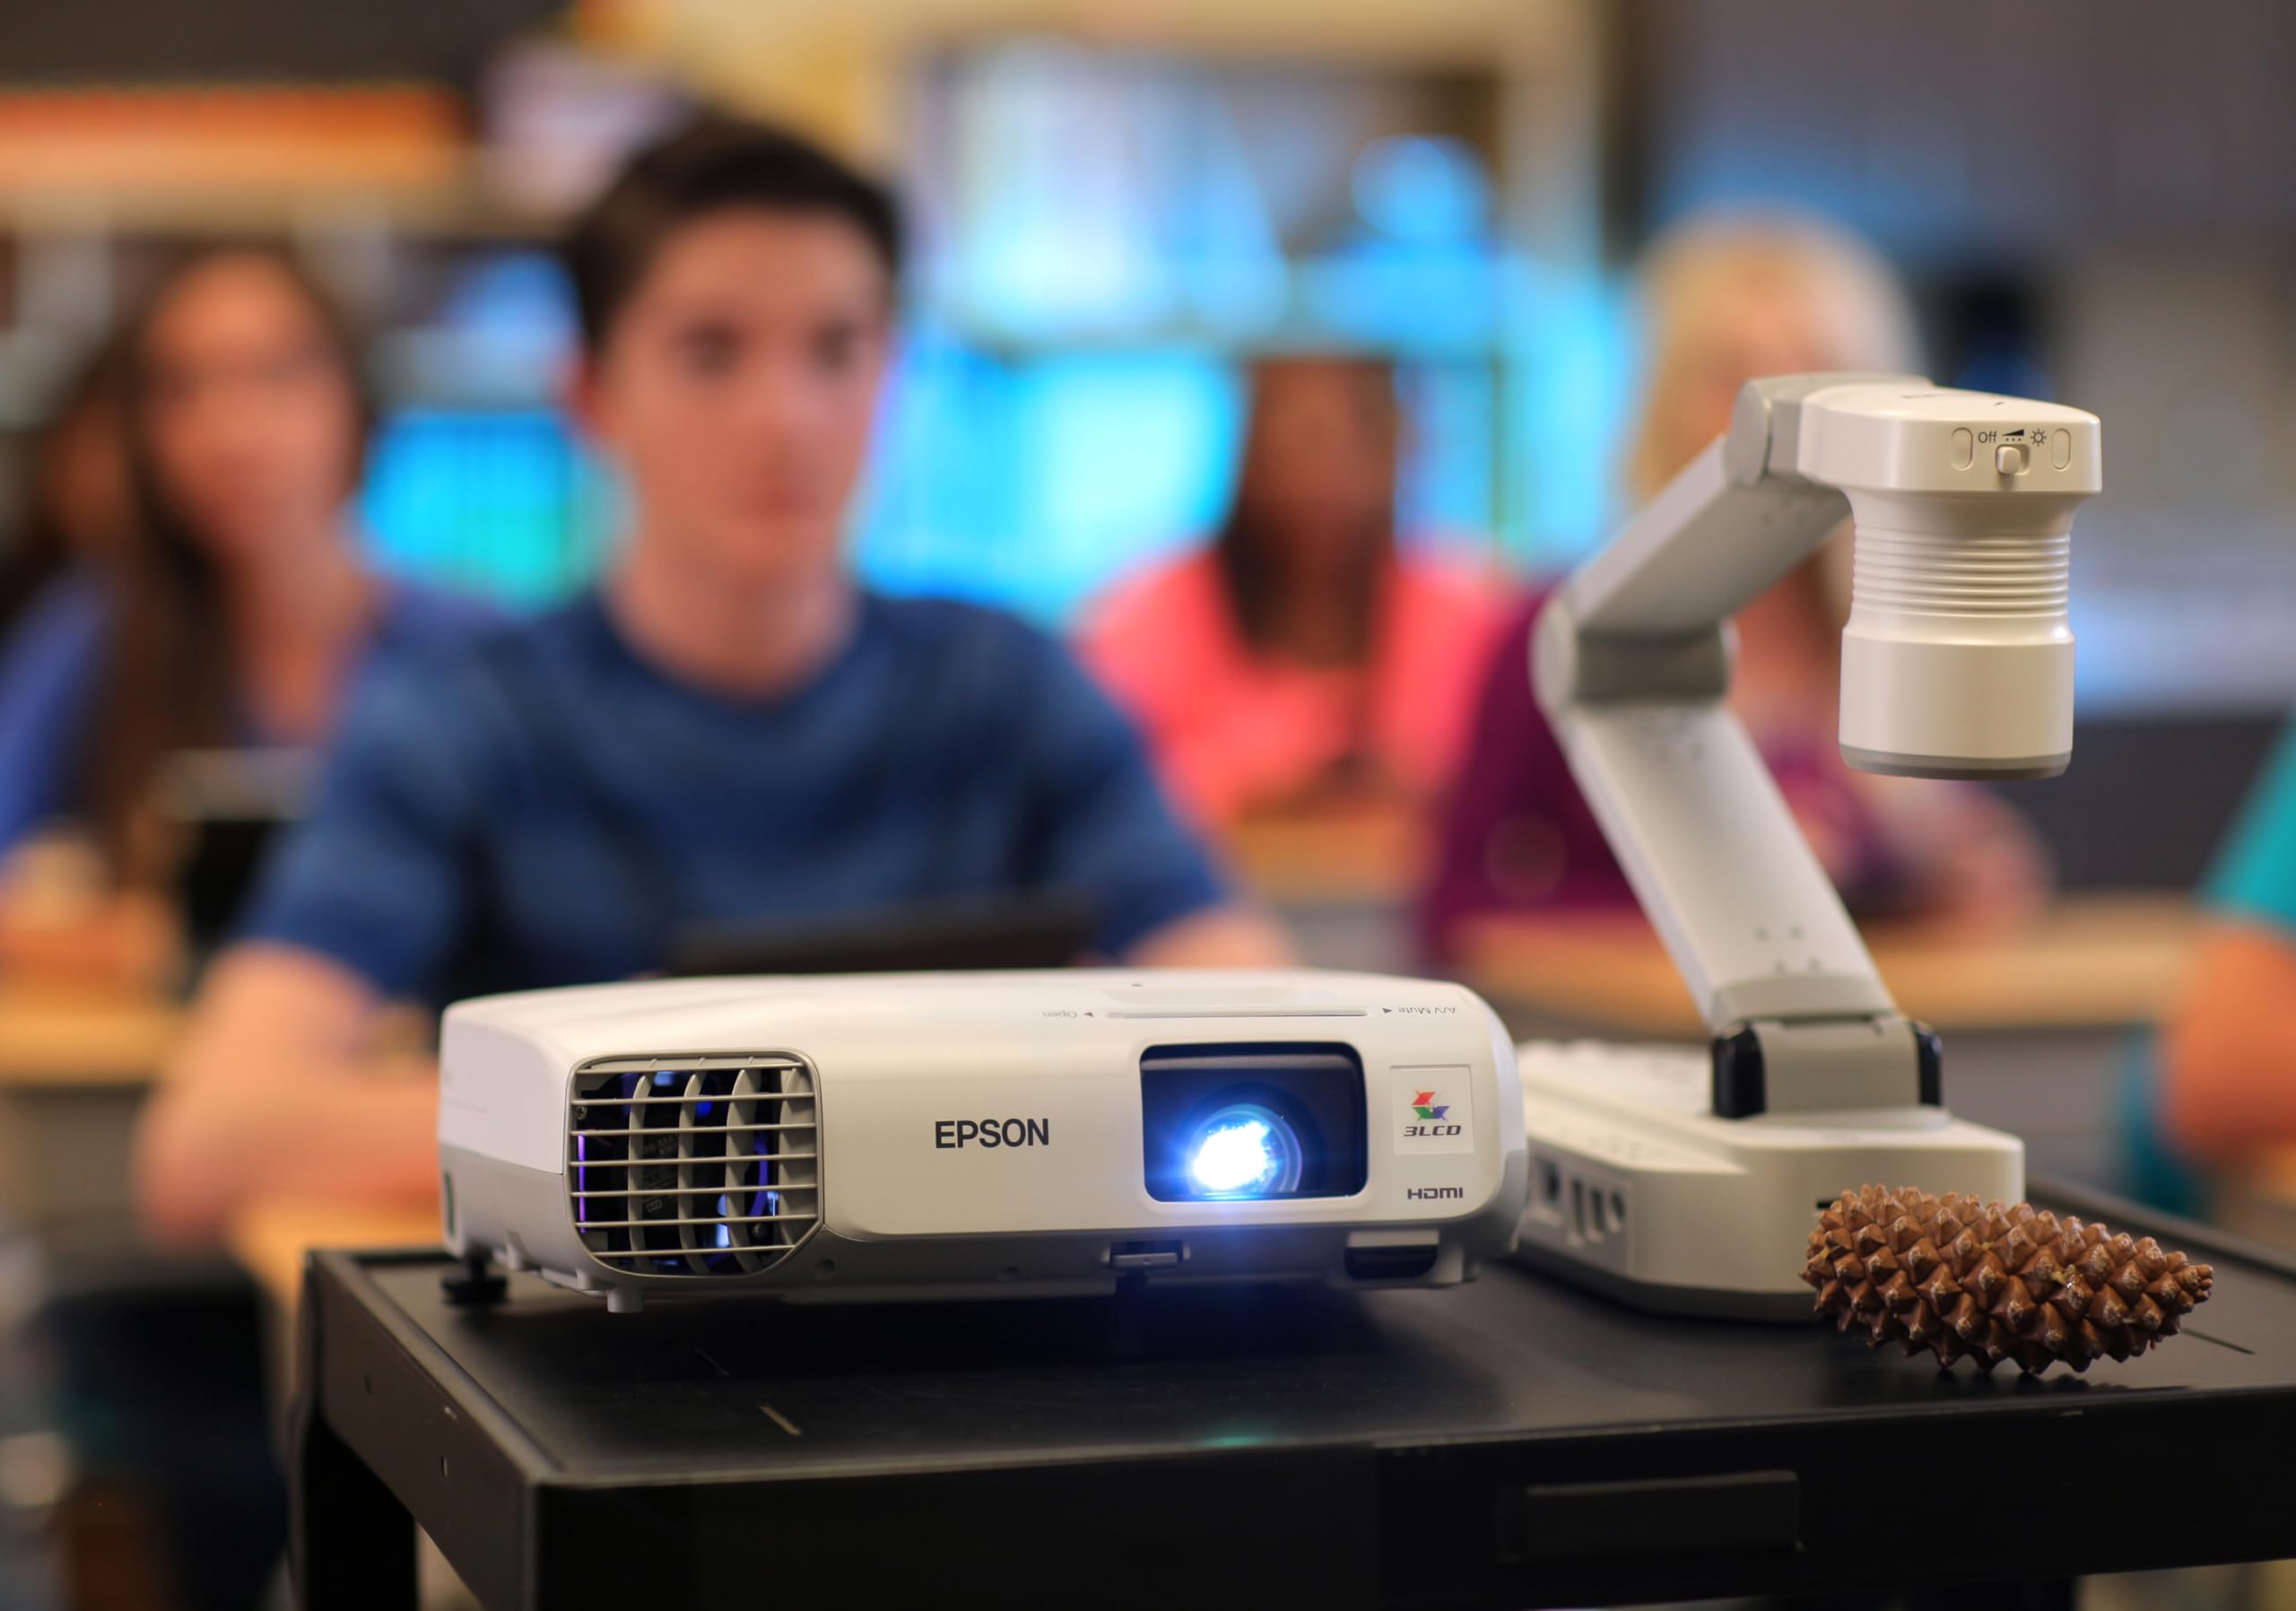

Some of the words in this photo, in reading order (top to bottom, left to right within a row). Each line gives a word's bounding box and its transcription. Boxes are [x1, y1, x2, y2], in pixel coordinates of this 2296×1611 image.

[1978, 431, 1996, 443] Off
[935, 1119, 1048, 1148] EPSON
[1404, 1125, 1462, 1137] 3LCD
[1407, 1187, 1463, 1199] HDMI
